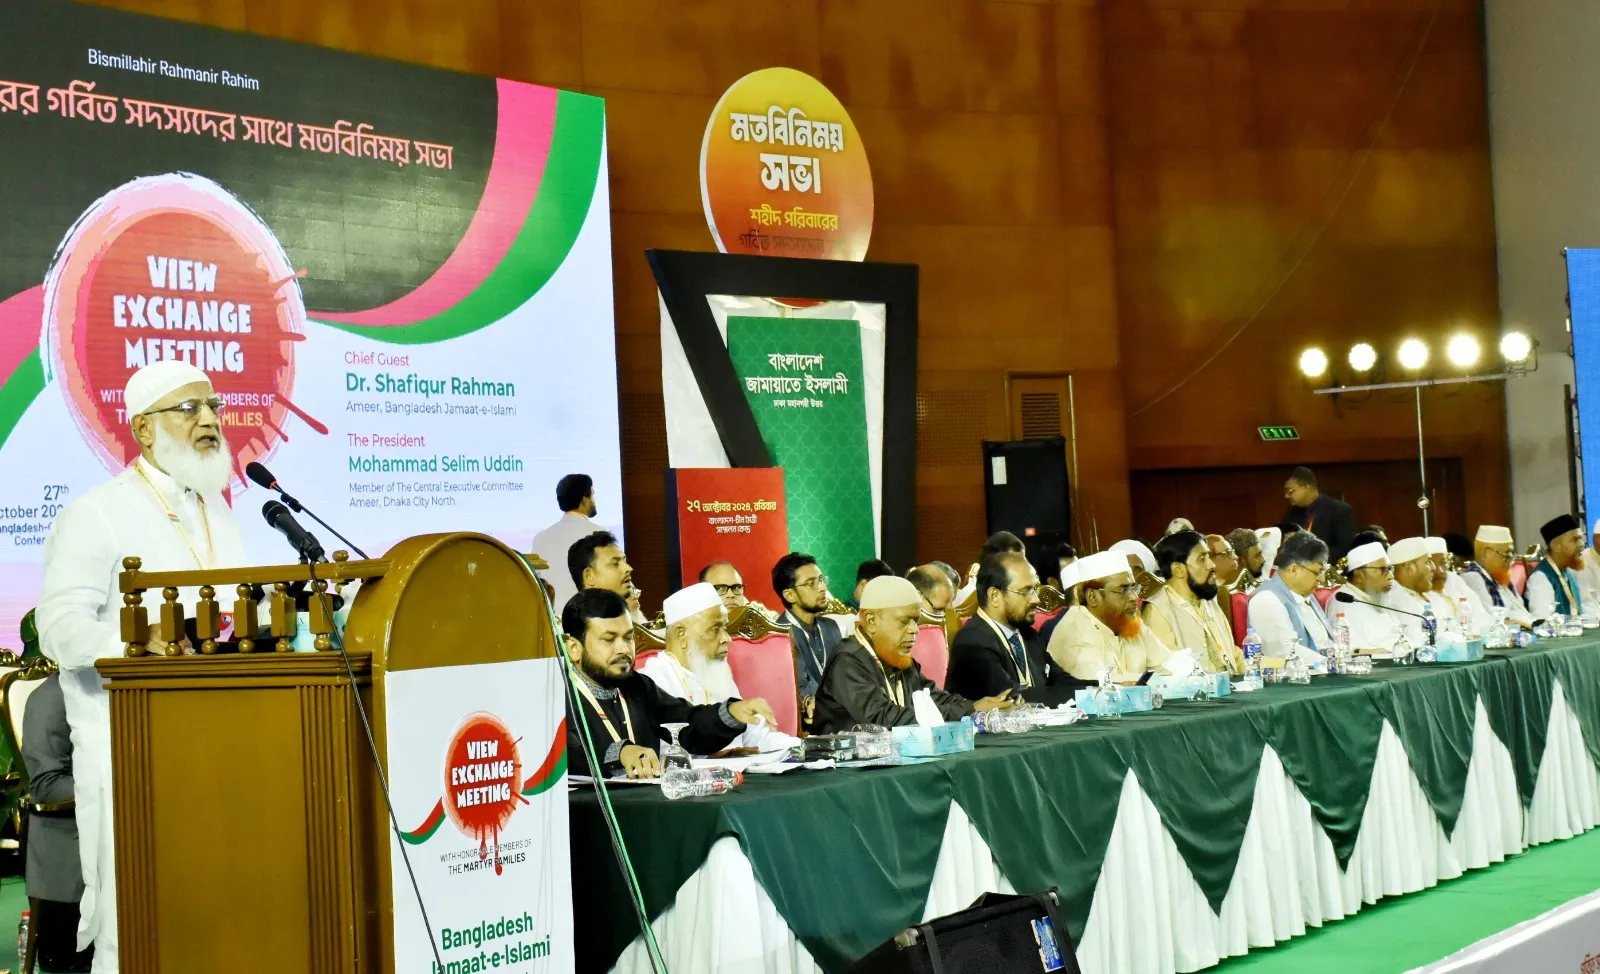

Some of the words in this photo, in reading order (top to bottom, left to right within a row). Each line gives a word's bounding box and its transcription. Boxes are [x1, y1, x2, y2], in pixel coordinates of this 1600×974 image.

[88, 48, 156, 74] Bismillahir
[160, 60, 218, 84] Rahmanir
[222, 71, 259, 90] Rahim
[47, 79, 118, 123] গর্বিত
[123, 98, 236, 142] সদস্যদের
[241, 115, 293, 148] সাথে
[297, 119, 410, 167] মতবিনিময়
[414, 141, 453, 170] সভা
[730, 105, 844, 153] মতবিনিময়
[760, 153, 822, 194] সভা
[749, 203, 781, 227] শহীদ
[784, 206, 839, 230] পরিবারের
[147, 255, 218, 292] VIEW
[113, 294, 252, 334] EXCHANGE
[125, 337, 244, 373] MEETING
[344, 351, 374, 365] Chief
[377, 353, 410, 367] Guest
[768, 353, 824, 372] বাংলাদেশ
[346, 372, 370, 392] Dr.
[375, 372, 446, 399] Shafiqur
[451, 376, 515, 397] Rahman
[744, 375, 802, 394] জামায়াতে
[804, 372, 849, 395] ইসলামী
[262, 393, 276, 407] OF
[346, 400, 383, 414] Ameer,
[385, 401, 442, 416] Bangladesh
[444, 402, 517, 416] Jamaat-e-Islami
[347, 433, 369, 447] The
[372, 433, 426, 447] President
[349, 454, 437, 473] Mohammad
[441, 454, 480, 473] Selim
[483, 454, 523, 472] Uddin
[349, 481, 384, 493] Member
[387, 481, 395, 492] of
[396, 481, 412, 492] The
[413, 480, 442, 492] Central
[444, 480, 480, 492] Executive
[482, 480, 523, 492] Committee
[0, 505, 39, 519] ctober
[350, 496, 382, 508] Ameer,
[384, 495, 411, 507] Dhaka
[413, 495, 430, 509] City
[432, 495, 456, 507] North
[686, 499, 701, 513] ২৭
[702, 501, 731, 514] অক্টোবর
[753, 499, 777, 512] রবিবার
[14, 535, 46, 546] Confer
[467, 740, 499, 760] VIEW
[452, 760, 514, 786] EXCHANGE
[457, 783, 511, 808] MEETING
[440, 852, 456, 863] WITH
[494, 841, 524, 853] MEMBERS
[524, 838, 533, 848] OF
[448, 864, 462, 875] THE
[463, 858, 493, 873] MARTYR
[494, 852, 526, 866] FAMILIES
[441, 911, 533, 951] Bangladesh
